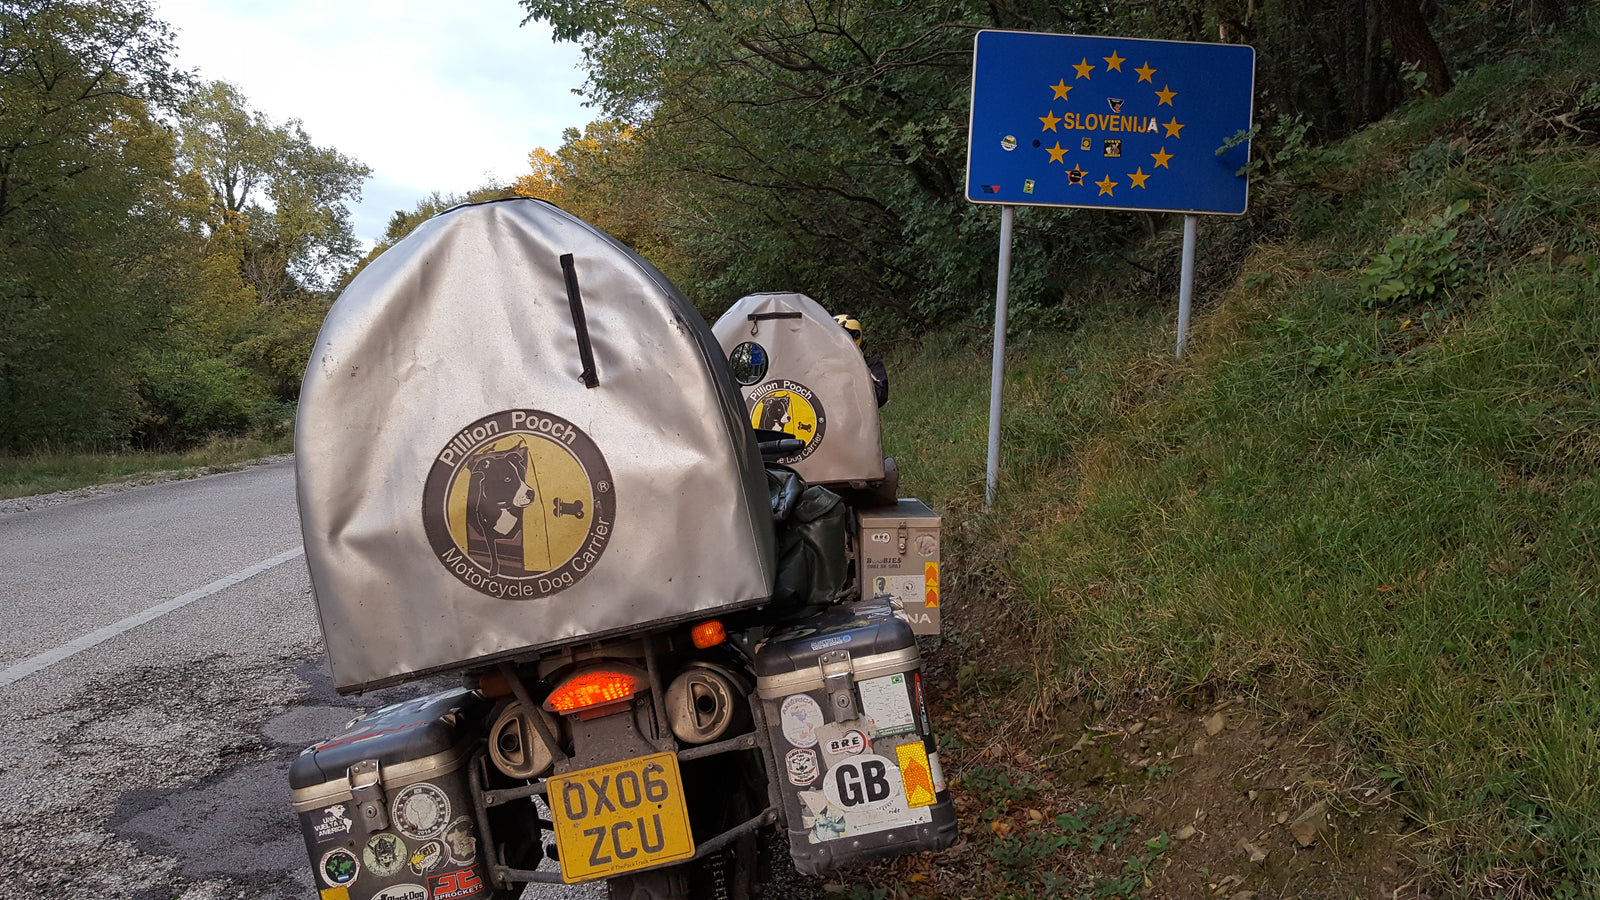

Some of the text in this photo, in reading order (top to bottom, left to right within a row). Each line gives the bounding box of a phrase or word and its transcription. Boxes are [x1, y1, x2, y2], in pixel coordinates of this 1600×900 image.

[1063, 112, 1159, 133] SLOVENIJA
[750, 380, 813, 401] Pillion Pooch
[439, 411, 578, 467] Pillion Pooch
[801, 433, 823, 457] Carrier
[442, 516, 610, 598] Motorcycle Dog Carrier
[831, 736, 860, 750] BRE
[562, 764, 669, 820] OX06
[835, 759, 891, 807] GB
[583, 813, 665, 867] ZCU
[434, 884, 484, 900] SPROCKETS
